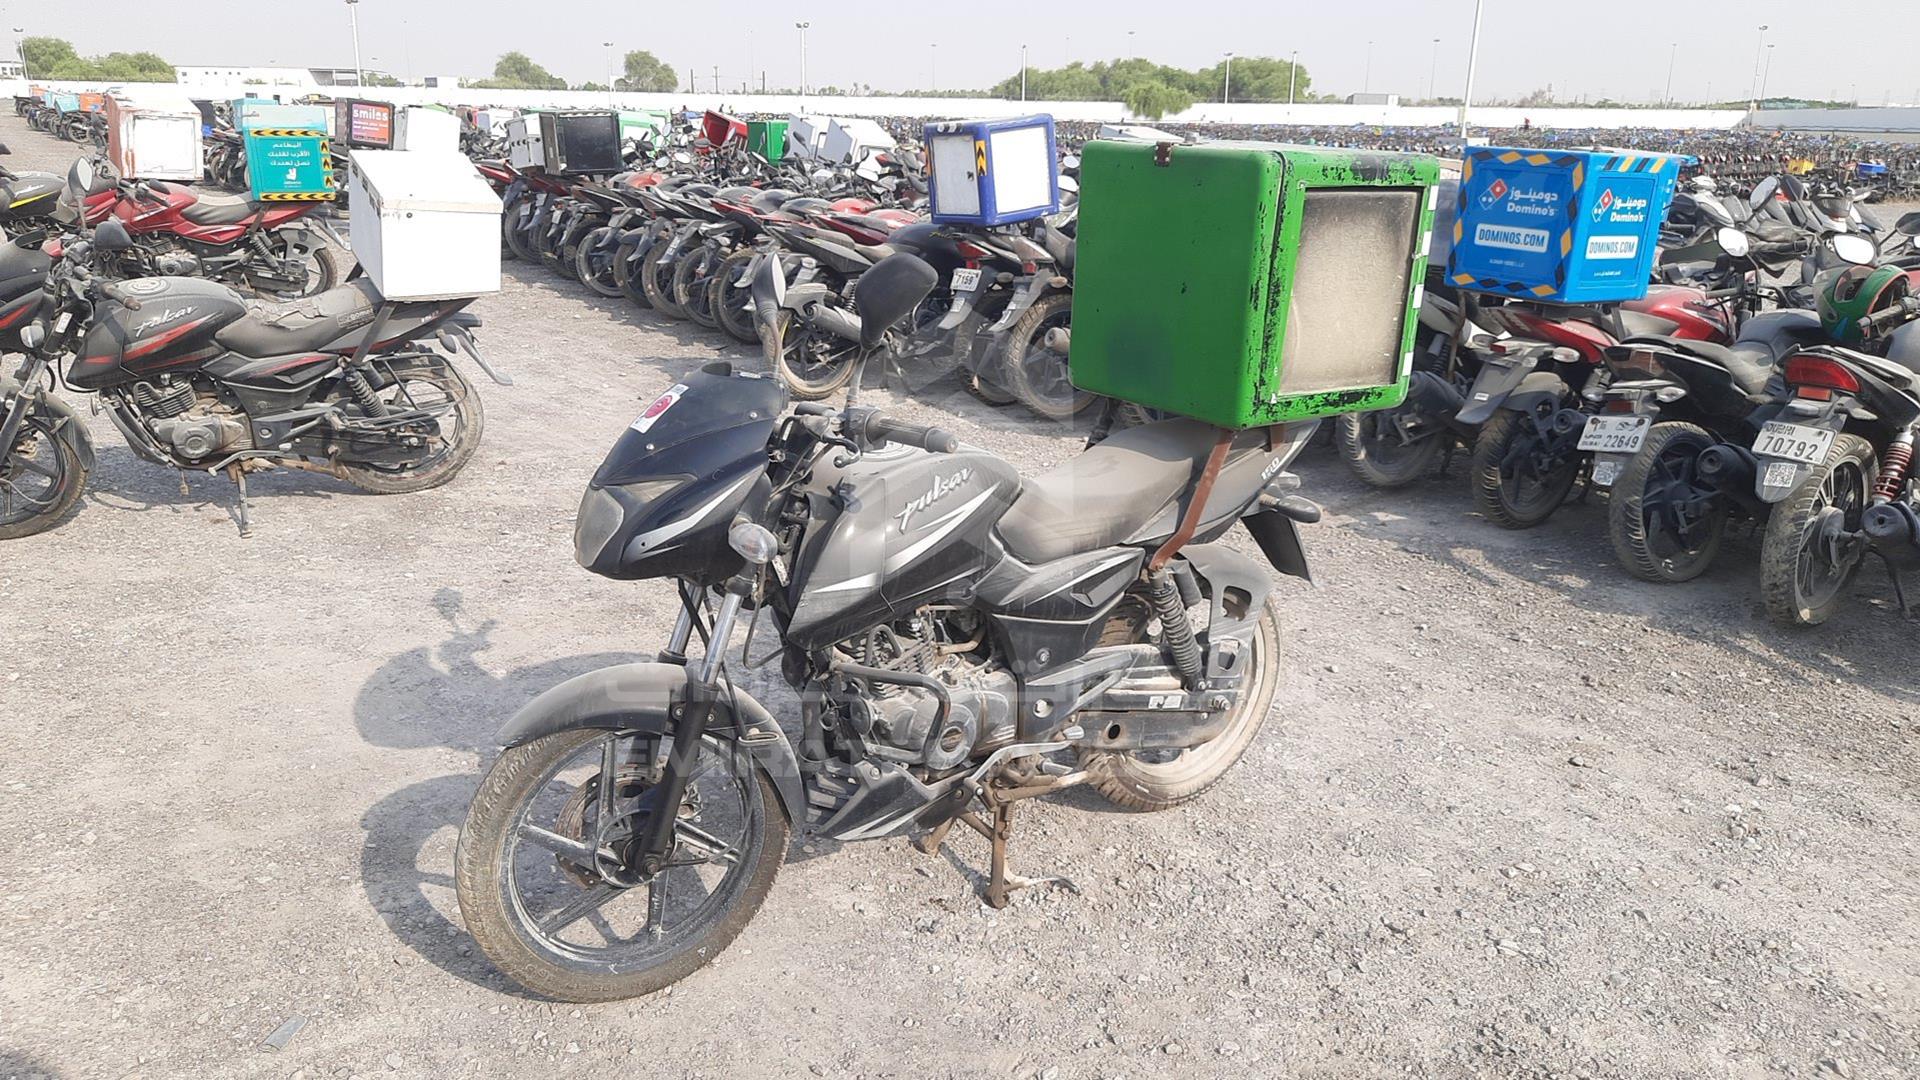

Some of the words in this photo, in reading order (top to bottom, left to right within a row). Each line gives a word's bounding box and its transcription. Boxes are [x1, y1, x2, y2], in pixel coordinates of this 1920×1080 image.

[353, 107, 388, 121] smiles
[1506, 202, 1556, 217] Domino's
[1610, 211, 1645, 223] Domino's
[1478, 228, 1546, 248] DOMINOS.COM
[1588, 241, 1635, 255] DOMINOS.COM
[1603, 434, 1640, 449] 22649
[1762, 436, 1818, 460] 70792
